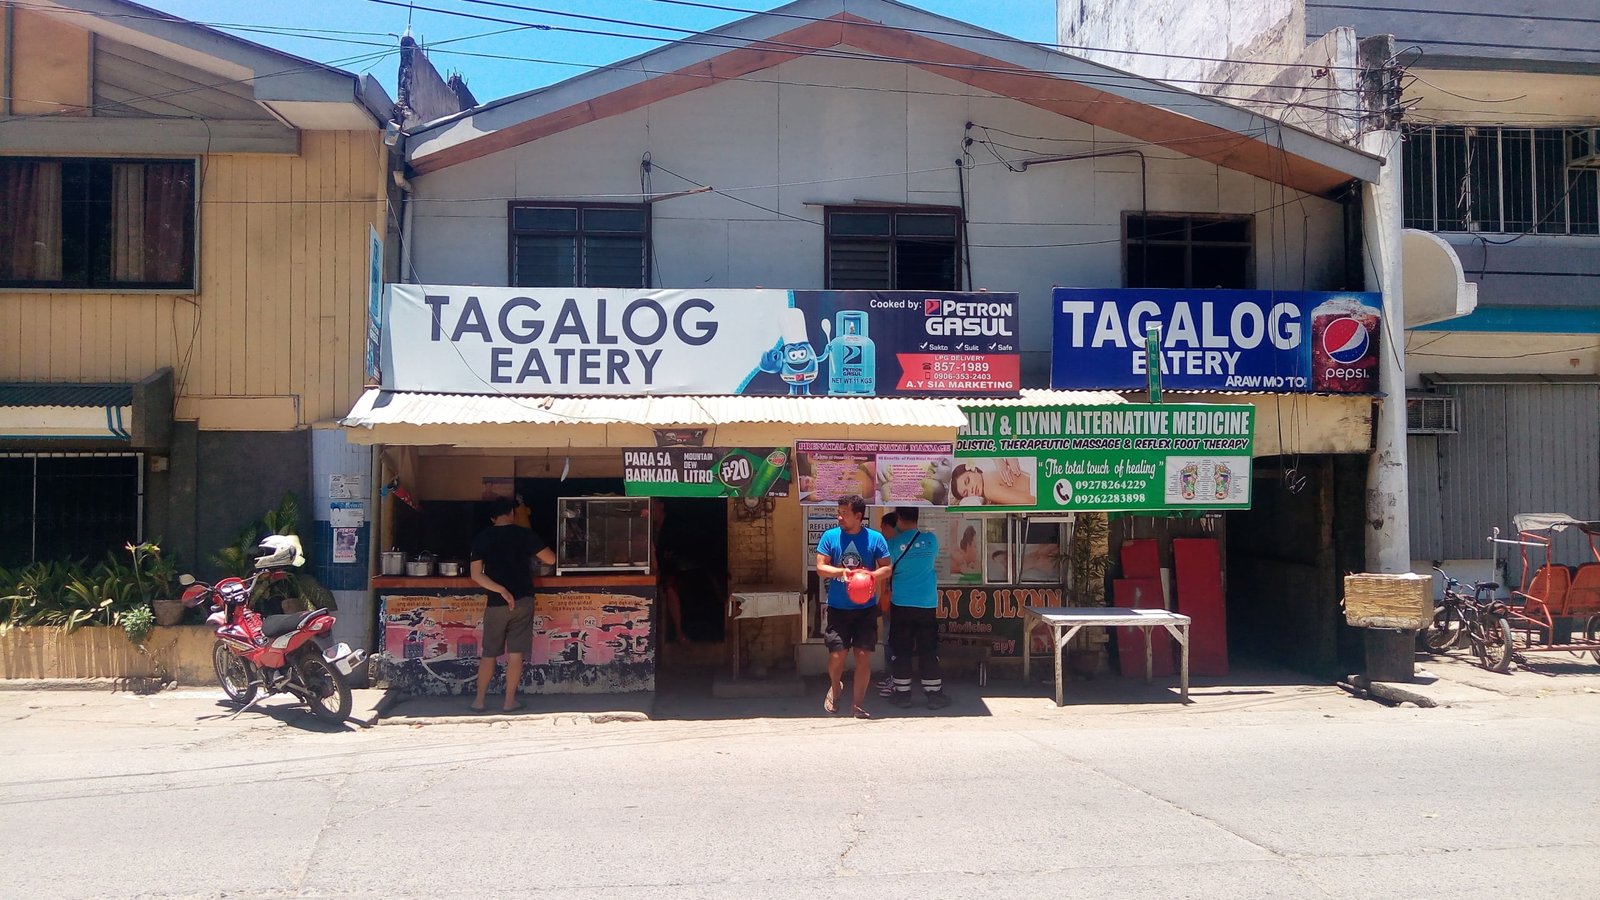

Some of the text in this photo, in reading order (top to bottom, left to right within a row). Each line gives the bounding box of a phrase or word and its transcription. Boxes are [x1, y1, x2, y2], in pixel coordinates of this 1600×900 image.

[870, 299, 922, 311] Cooked by:
[943, 301, 1012, 317] PETRON
[425, 295, 719, 346] TAGALOG
[925, 318, 1013, 336] GASUL
[1062, 301, 1302, 350] TAGALOG
[929, 343, 1013, 351] Sakto Sulit Safe
[490, 347, 664, 385] EATERY
[934, 362, 989, 372] 857-1989
[1325, 368, 1367, 381] pepsi
[949, 381, 1013, 389] MARKETING
[1225, 376, 1261, 388] ARAW
[1263, 377, 1284, 388] MO
[957, 411, 1250, 436] ALLY & ILYNN ALTERNATIVE MEDICINE
[798, 442, 951, 452] PRENATAL & POST NATAL MASSAGE
[1000, 438, 1070, 450] THERAPEUTIC
[1072, 439, 1121, 450] MASSAGE
[1123, 439, 1132, 450] &
[1134, 438, 1171, 450] REFLEX
[1174, 438, 1201, 450] FOOT
[1203, 438, 1249, 450] THERAPY
[624, 452, 672, 466] PARA SA
[684, 453, 713, 461] MOUNTAIN
[1065, 460, 1085, 474] total
[1087, 460, 1109, 474] touch
[1114, 460, 1123, 478] of
[625, 469, 679, 483] BARKADA
[684, 470, 713, 483] LITRO
[1075, 480, 1146, 490] 09278264229
[1075, 494, 1146, 504] 09262283898
[969, 589, 987, 618] &
[993, 589, 1063, 618] ILYNN
